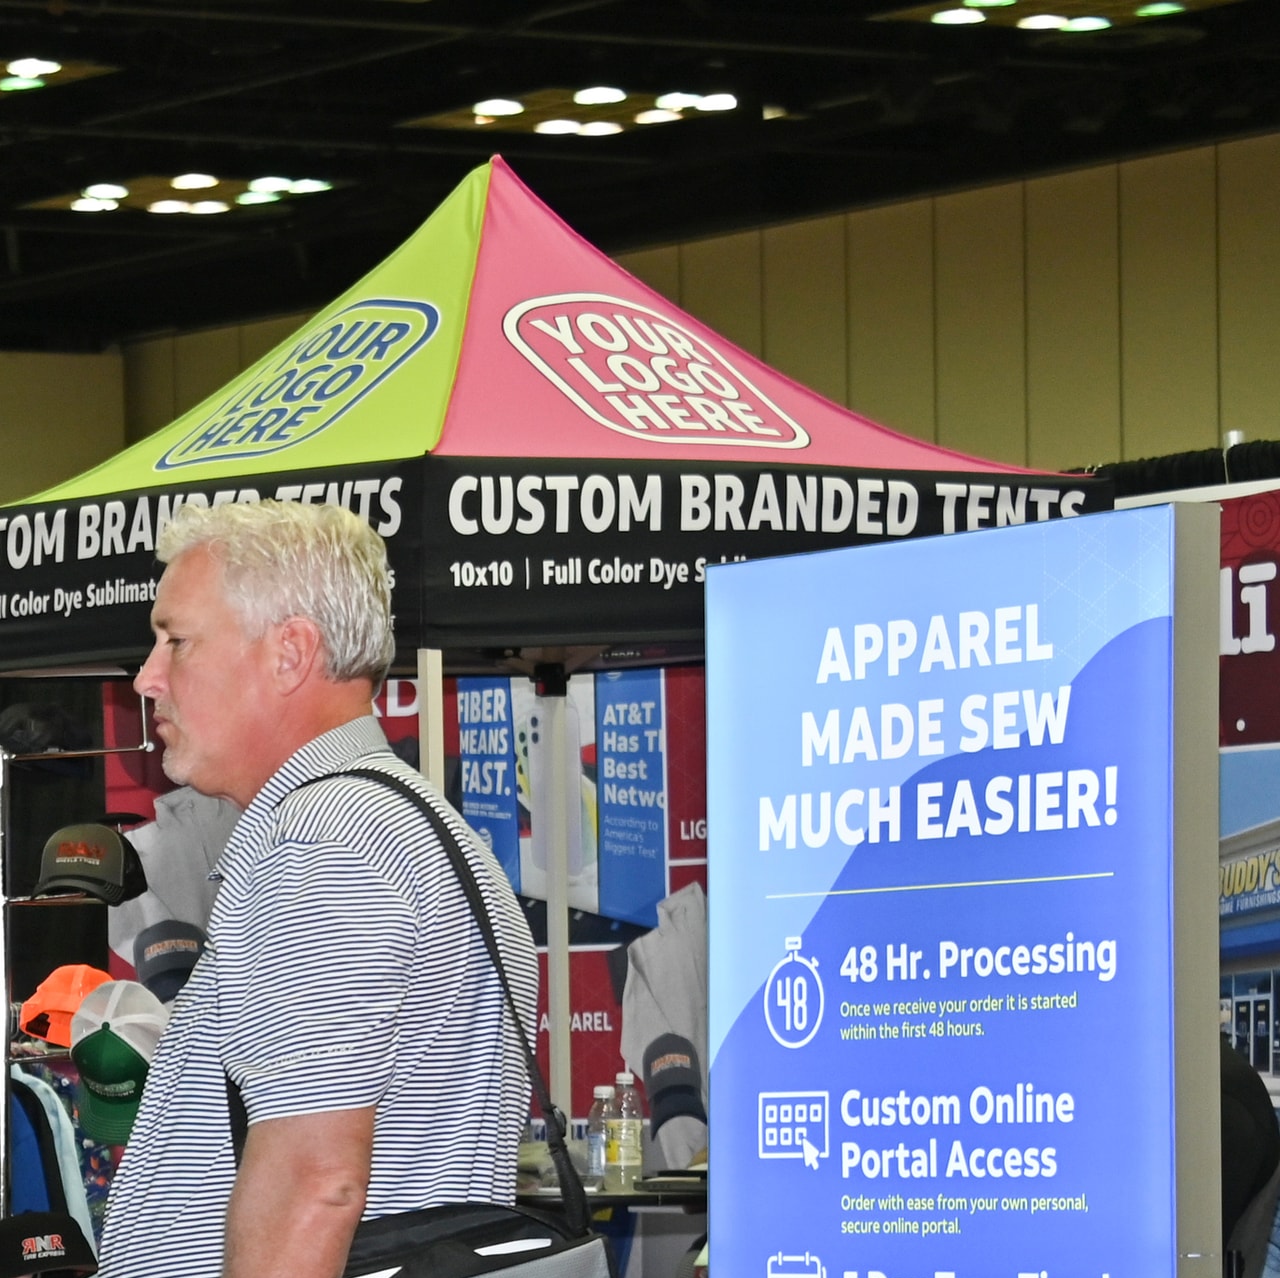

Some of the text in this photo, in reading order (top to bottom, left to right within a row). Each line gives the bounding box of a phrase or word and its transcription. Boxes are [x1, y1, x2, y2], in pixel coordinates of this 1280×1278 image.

[273, 320, 411, 373] YOUR
[529, 313, 713, 366] YOUR
[224, 363, 364, 416] LOGO
[565, 354, 740, 400] LOGO
[178, 405, 323, 456] HERE
[604, 394, 783, 437] HERE
[448, 474, 662, 535] CUSTOM
[679, 473, 920, 536] BRANDED
[450, 561, 513, 587] 10x10
[543, 557, 582, 585] Full
[588, 556, 644, 584] Color
[649, 557, 689, 590] Dye
[10, 590, 50, 617] Color
[53, 587, 82, 617] Dye
[816, 603, 1053, 684] APPAREL
[458, 688, 507, 724] FIBER
[602, 701, 655, 726] AT&T
[801, 685, 1072, 767] MADE SEW
[459, 728, 509, 756] MEANS
[603, 730, 640, 754] Has
[461, 761, 511, 797] FAST.
[603, 758, 647, 781] Best
[759, 766, 1118, 851] MUCH EASIER!
[840, 932, 1117, 983] 48 Hr. Processing
[777, 976, 808, 1031] 48
[840, 991, 1078, 1018] Once receive your order started
[840, 1020, 985, 1040] within the first 48 hours.
[841, 1083, 1075, 1126] Custom Online
[841, 1138, 1058, 1179] Portal Access
[841, 1193, 1089, 1215] Order with ease from your own personal,
[841, 1217, 961, 1237] secure online portal.
